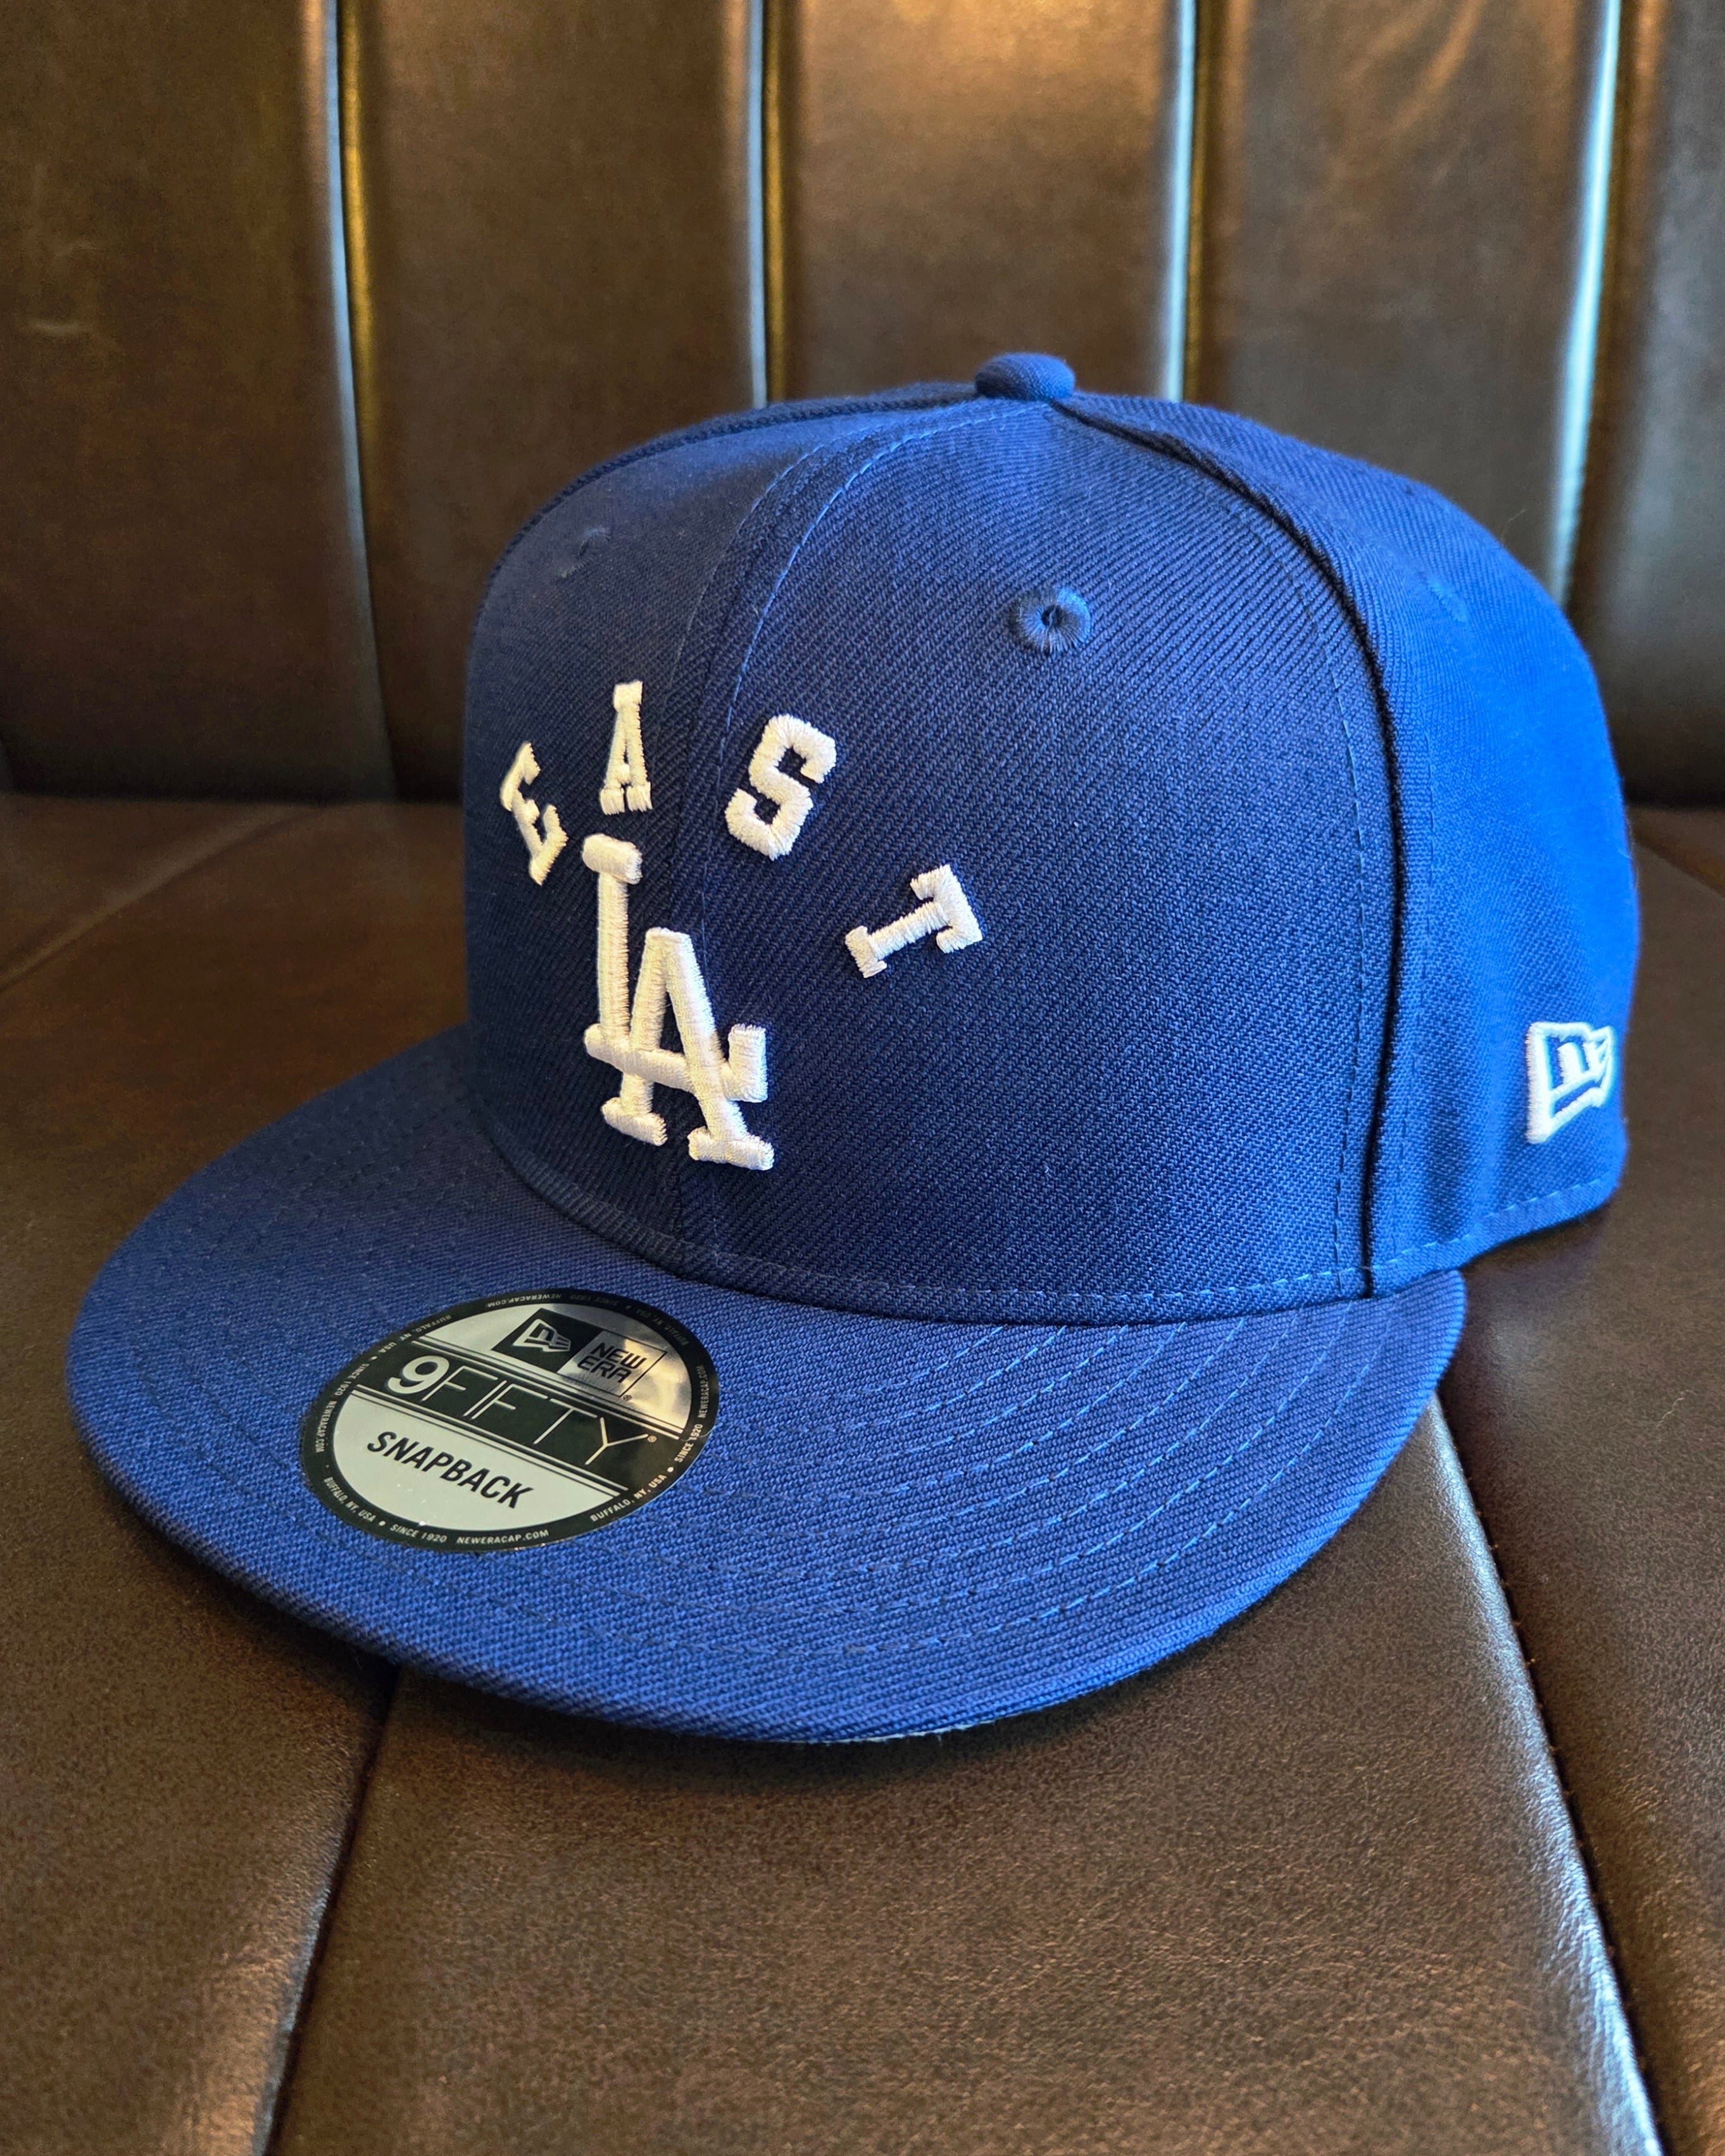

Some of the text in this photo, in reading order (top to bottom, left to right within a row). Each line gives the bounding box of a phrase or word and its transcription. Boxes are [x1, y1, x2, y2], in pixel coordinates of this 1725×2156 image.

[498, 680, 982, 979] EAST
[581, 833, 775, 1171] LA
[486, 1293, 562, 1308] NEWERACAP.COM
[350, 1363, 370, 1380] SINCE
[379, 1341, 397, 1353] USA
[577, 1355, 632, 1384] ERA
[591, 1343, 647, 1369] NEW
[334, 1380, 352, 1396] 1920
[387, 1355, 648, 1465] 9FIFTY
[315, 1400, 337, 1453] NEWERACAP.COM
[590, 1498, 635, 1522] BUFFALO,
[649, 1474, 667, 1488] USA
[674, 1442, 694, 1463] SINCE
[689, 1424, 704, 1442] 1920
[697, 1364, 708, 1419] NEWERACAP.COM
[367, 1431, 534, 1509] SNAPBACK
[323, 1476, 348, 1504] BUFFALO,
[358, 1510, 375, 1522] USA
[389, 1524, 418, 1538] SINCE
[420, 1532, 447, 1543] 1920
[456, 1529, 549, 1545] NEWERACAP.COM
